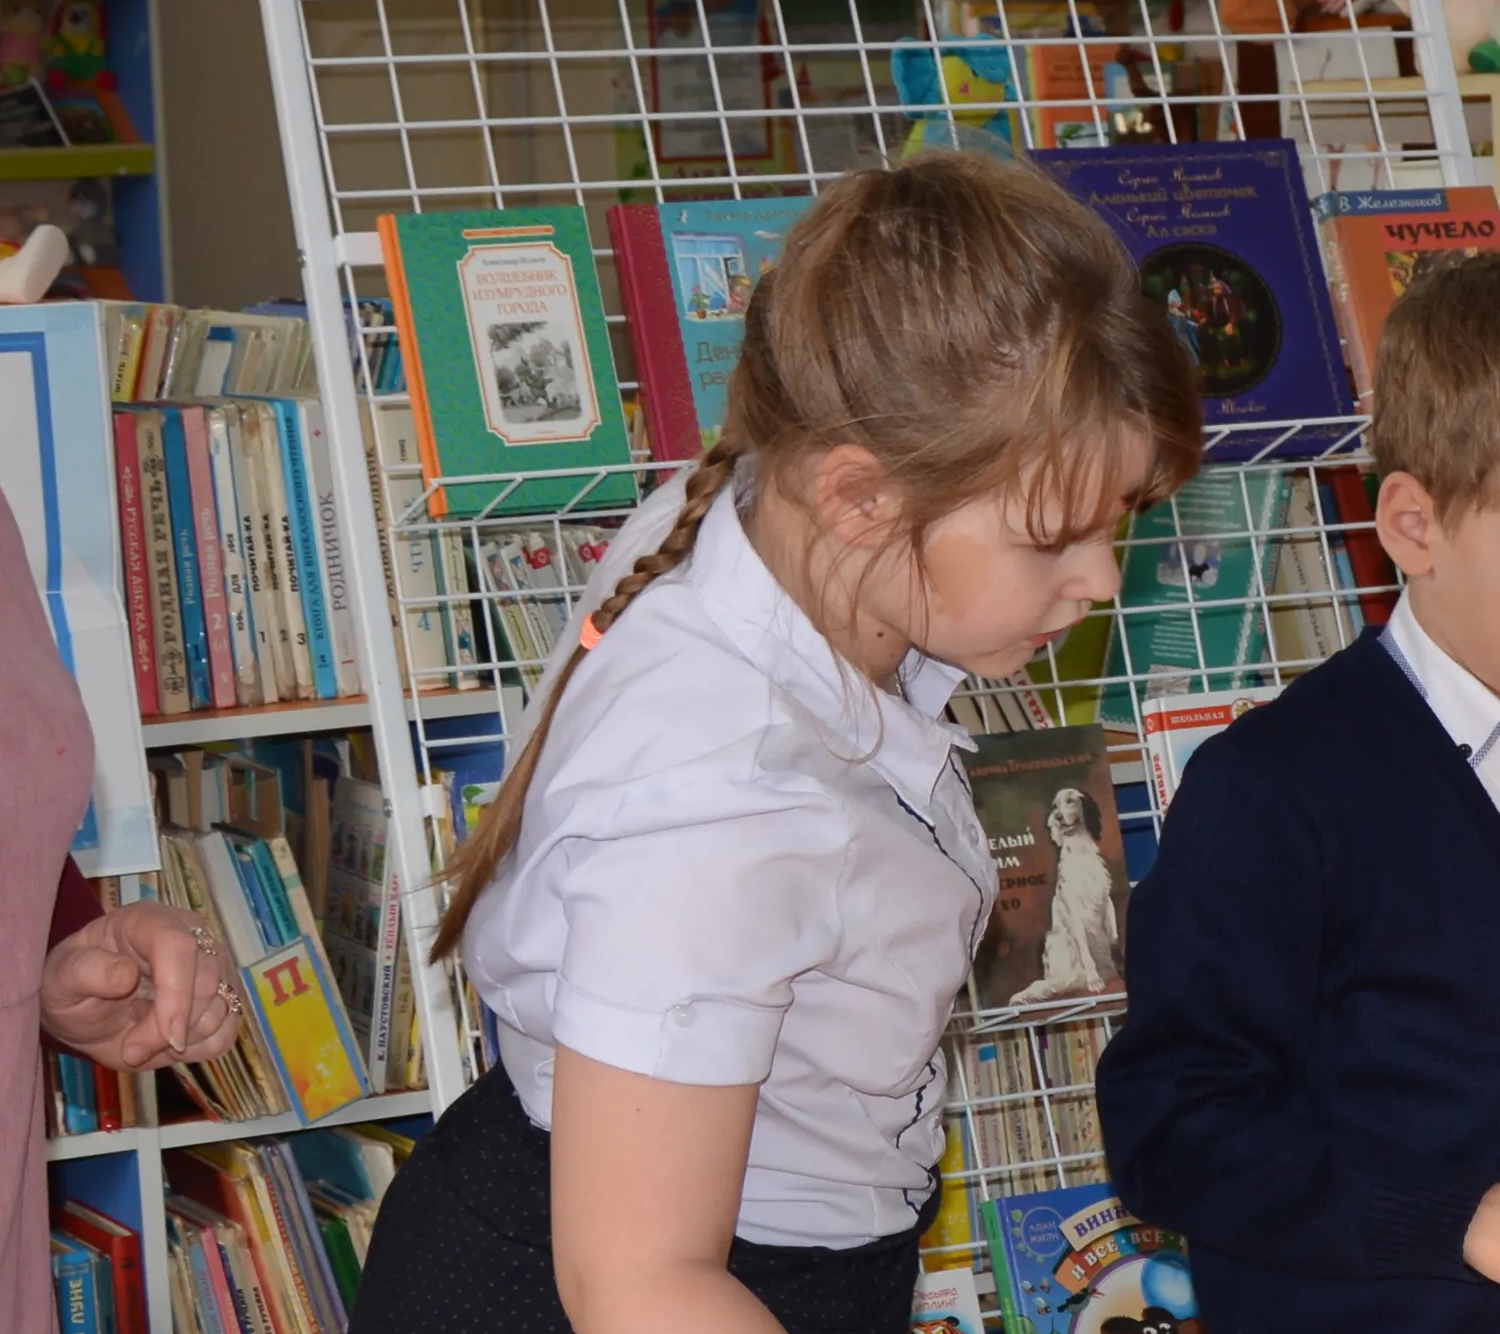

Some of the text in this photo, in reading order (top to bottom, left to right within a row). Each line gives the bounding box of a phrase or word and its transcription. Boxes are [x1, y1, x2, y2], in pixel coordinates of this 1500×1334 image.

[1357, 193, 1443, 209] Железников
[1384, 219, 1496, 244] ЧУЧЕЛО
[476, 269, 559, 285] ВОЛШЕБНИК
[472, 284, 568, 302] ИЗУМРУДНОГО
[496, 301, 549, 315] ГОРОДА
[148, 479, 179, 645] РОДНАЯ РЕЧЬ
[242, 515, 261, 592] ПОЧИТАЙ-КА
[280, 515, 299, 592] ПОЧИТАЙ-КА
[319, 491, 347, 611] РОДНИЧОК
[1170, 710, 1225, 725] ШКОЛЬНАЯ
[989, 826, 1035, 851] ЕЛЫЙ
[995, 856, 1021, 870] ИМ
[999, 873, 1047, 891] ЕРНОЕ
[262, 955, 309, 1006] П
[378, 964, 392, 1048] ПАУСТОВСКИЙ
[1073, 1204, 1128, 1238] ВИНН
[1084, 1238, 1119, 1266] ВСЕ
[1130, 1230, 1165, 1245] ВСЕ
[68, 1278, 84, 1325] ЛУНЕ
